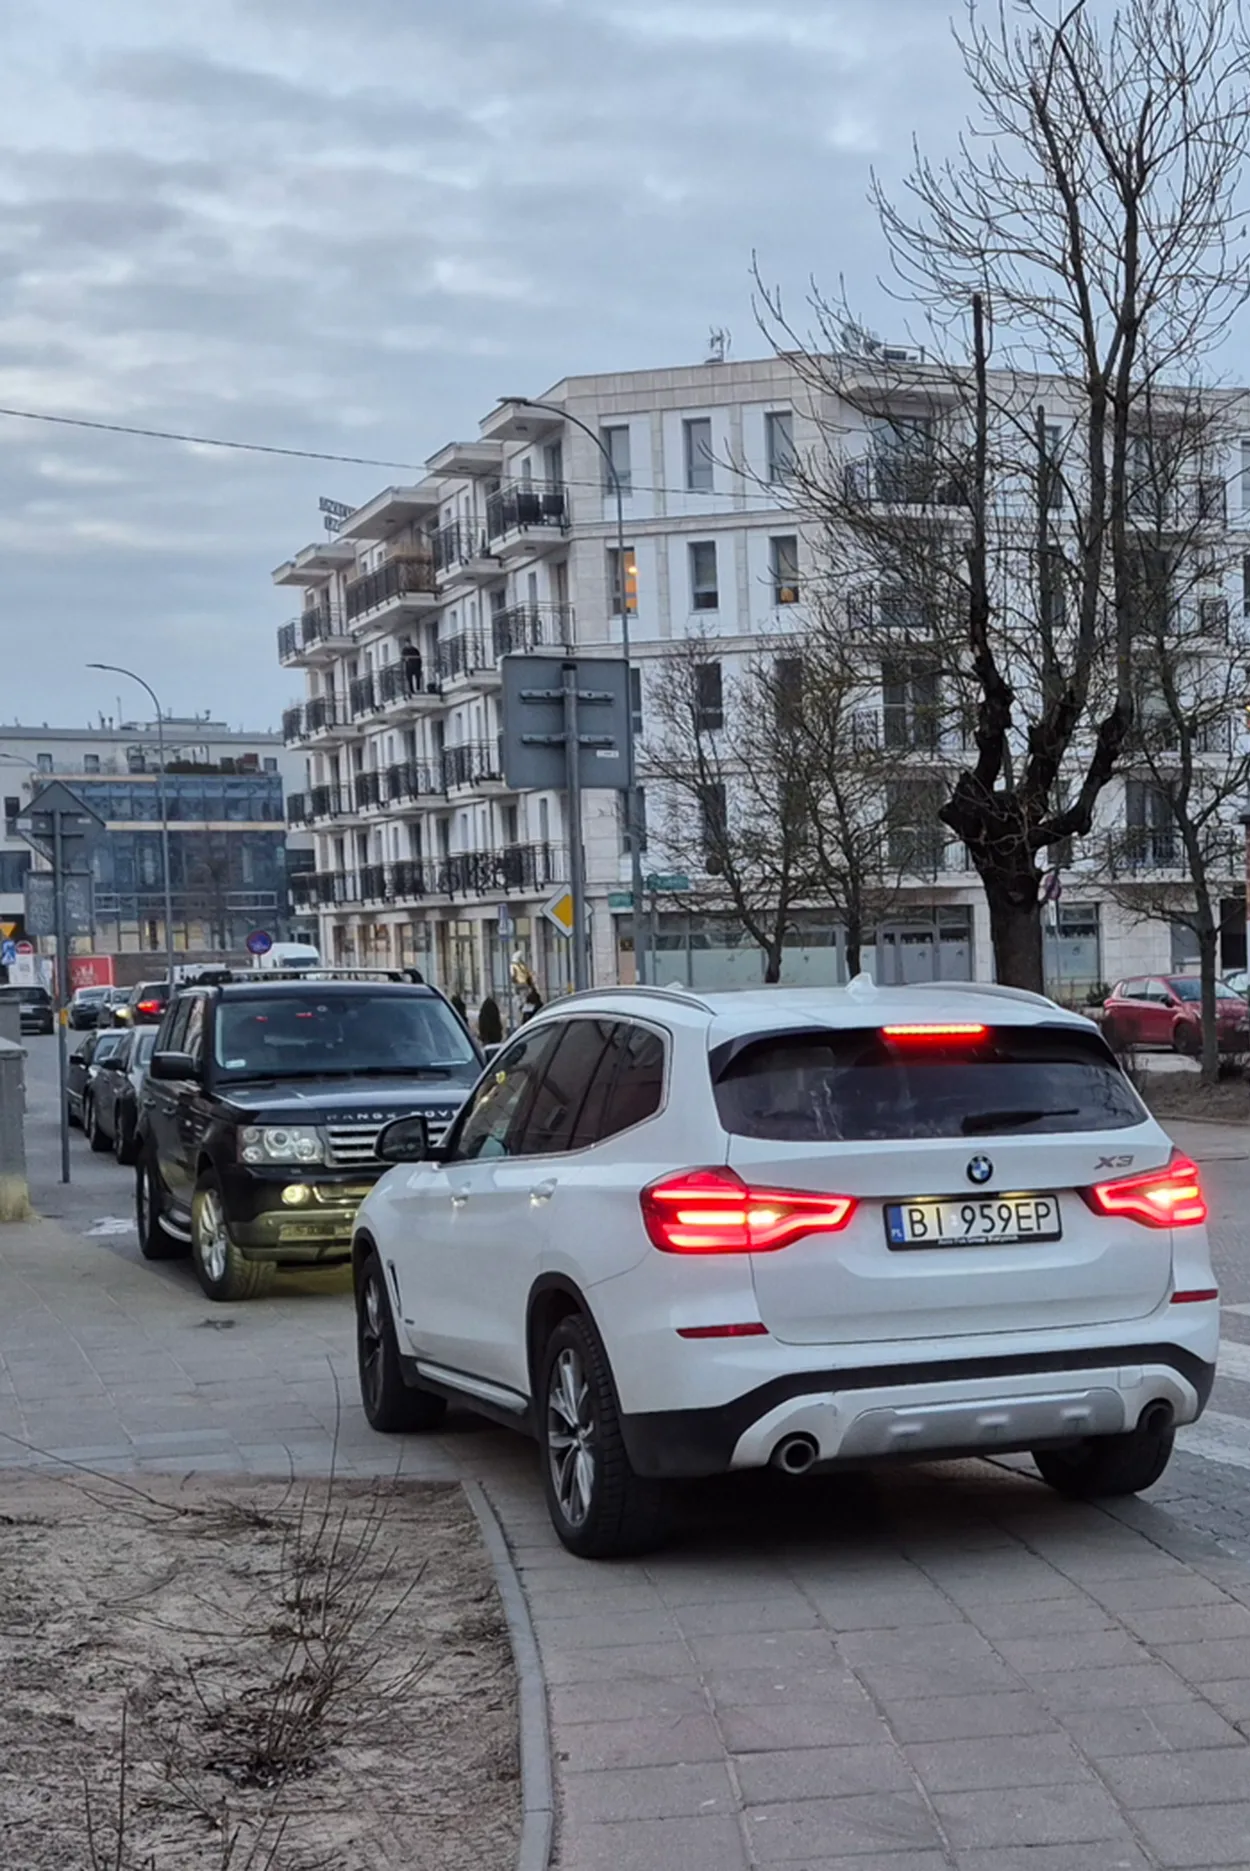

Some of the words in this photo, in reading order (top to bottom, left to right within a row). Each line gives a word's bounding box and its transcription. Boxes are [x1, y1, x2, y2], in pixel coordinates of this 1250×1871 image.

[1094, 1155, 1134, 1170] X3
[908, 1207, 943, 1238] BI
[960, 1202, 1051, 1235] 959EP
